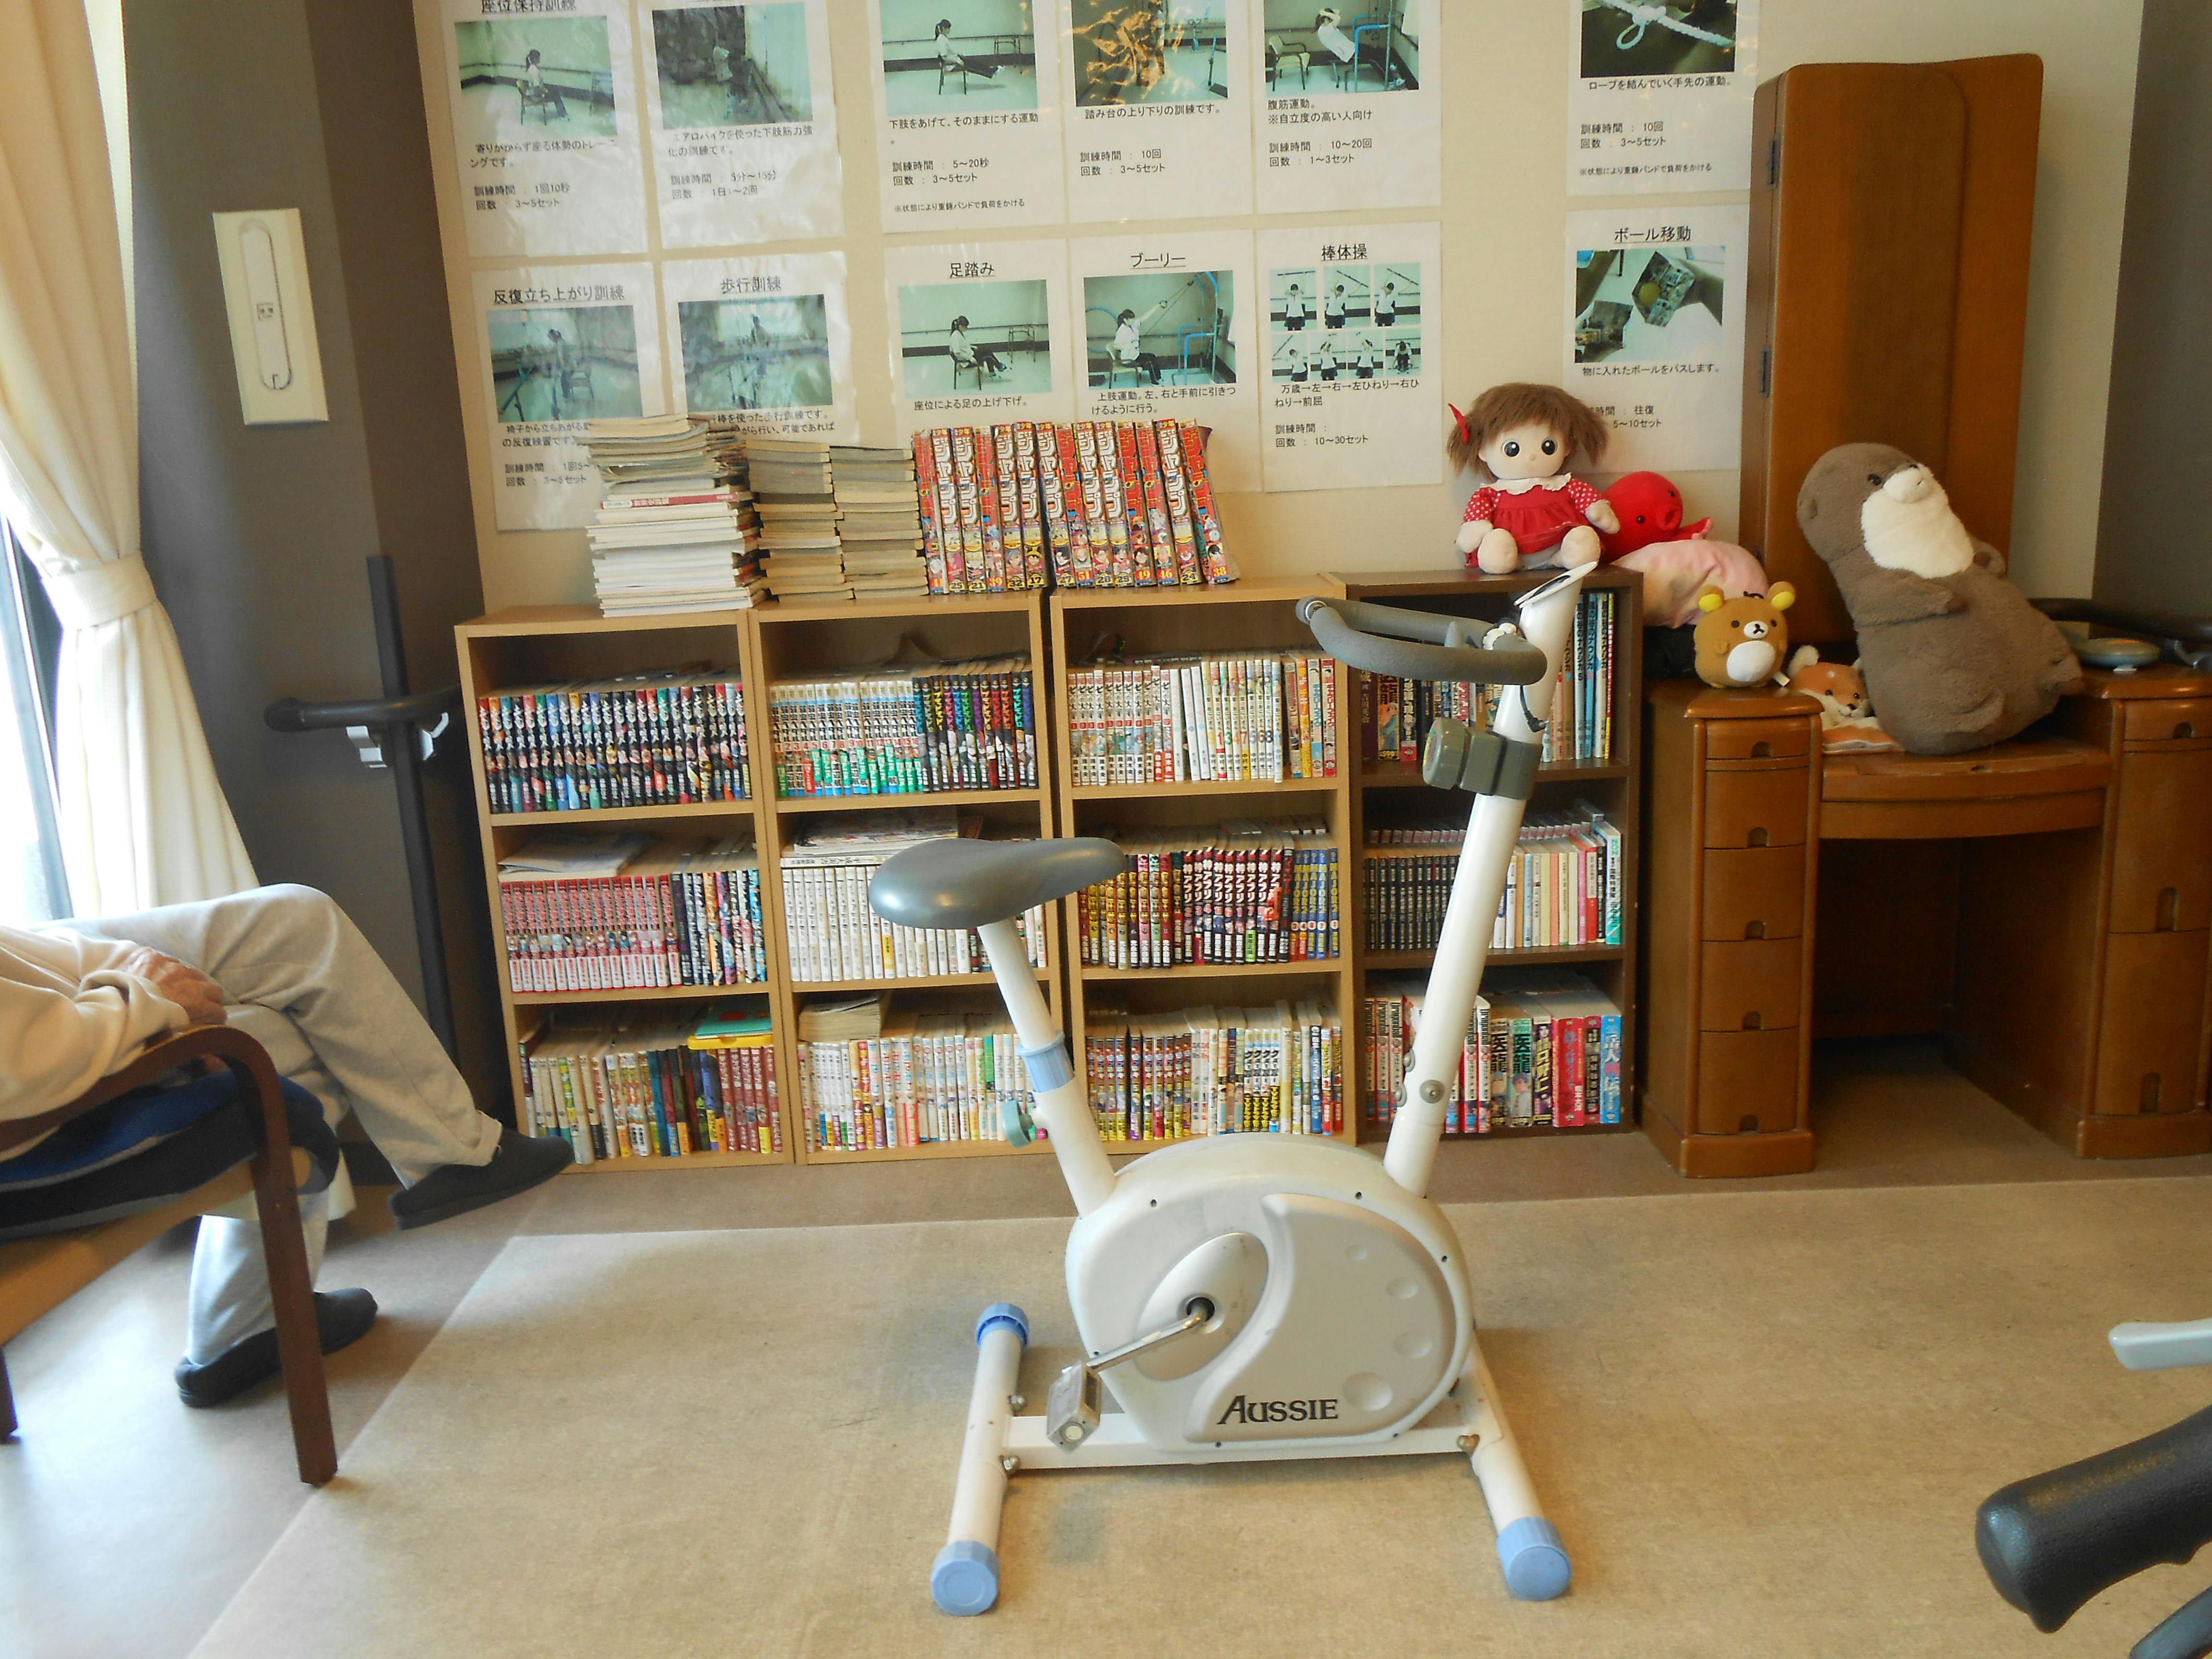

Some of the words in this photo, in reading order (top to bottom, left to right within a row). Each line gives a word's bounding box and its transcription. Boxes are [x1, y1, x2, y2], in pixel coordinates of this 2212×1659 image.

[1085, 104, 1221, 120] 踏み台の上り下りの訓練です。
[1268, 99, 1315, 110] 腹筋運動。
[1614, 226, 1692, 242] ボール移動
[1321, 243, 1368, 262] 棒体操
[950, 262, 995, 278] 足踏み
[721, 276, 781, 294] 歩行訓練
[494, 285, 625, 304] 反復立ち上がり訓練
[914, 397, 1028, 411] 座位による足の上げ下げ。
[1092, 404, 1158, 416] けるように行う。
